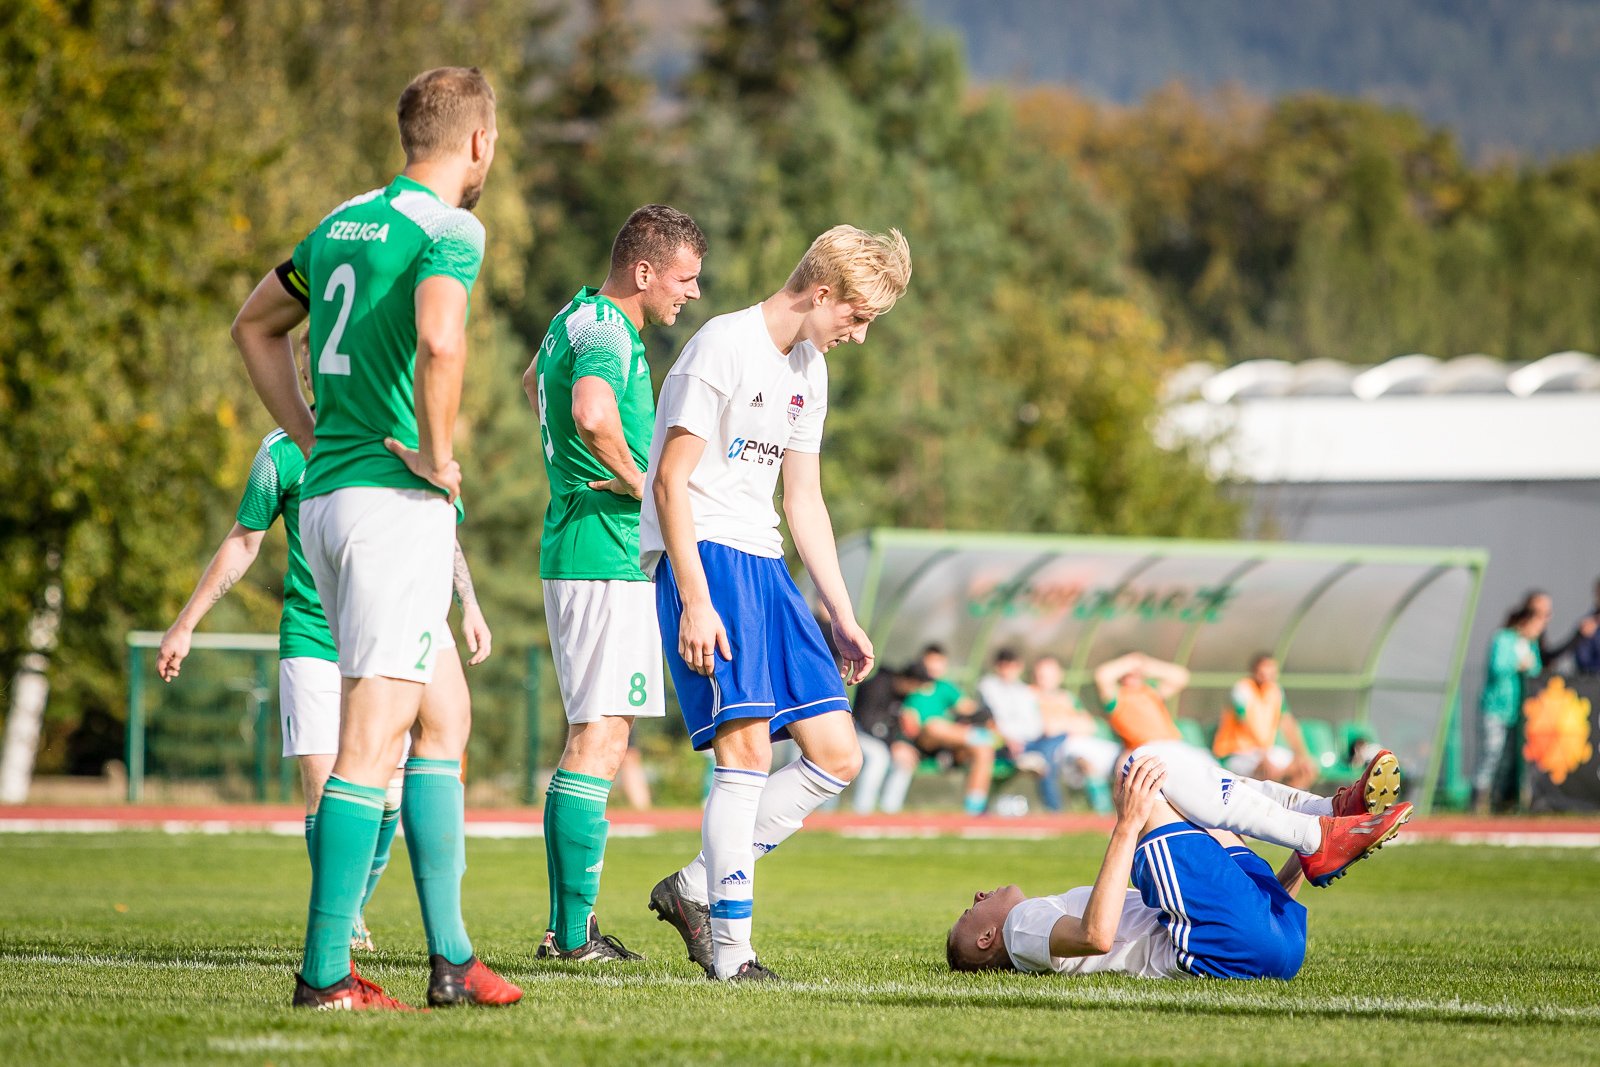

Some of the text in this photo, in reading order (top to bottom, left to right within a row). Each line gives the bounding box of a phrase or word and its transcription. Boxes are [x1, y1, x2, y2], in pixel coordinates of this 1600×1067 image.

[326, 220, 390, 243] SZELIGA
[318, 263, 356, 376] 2
[414, 631, 432, 671] 2
[628, 672, 647, 707] 8
